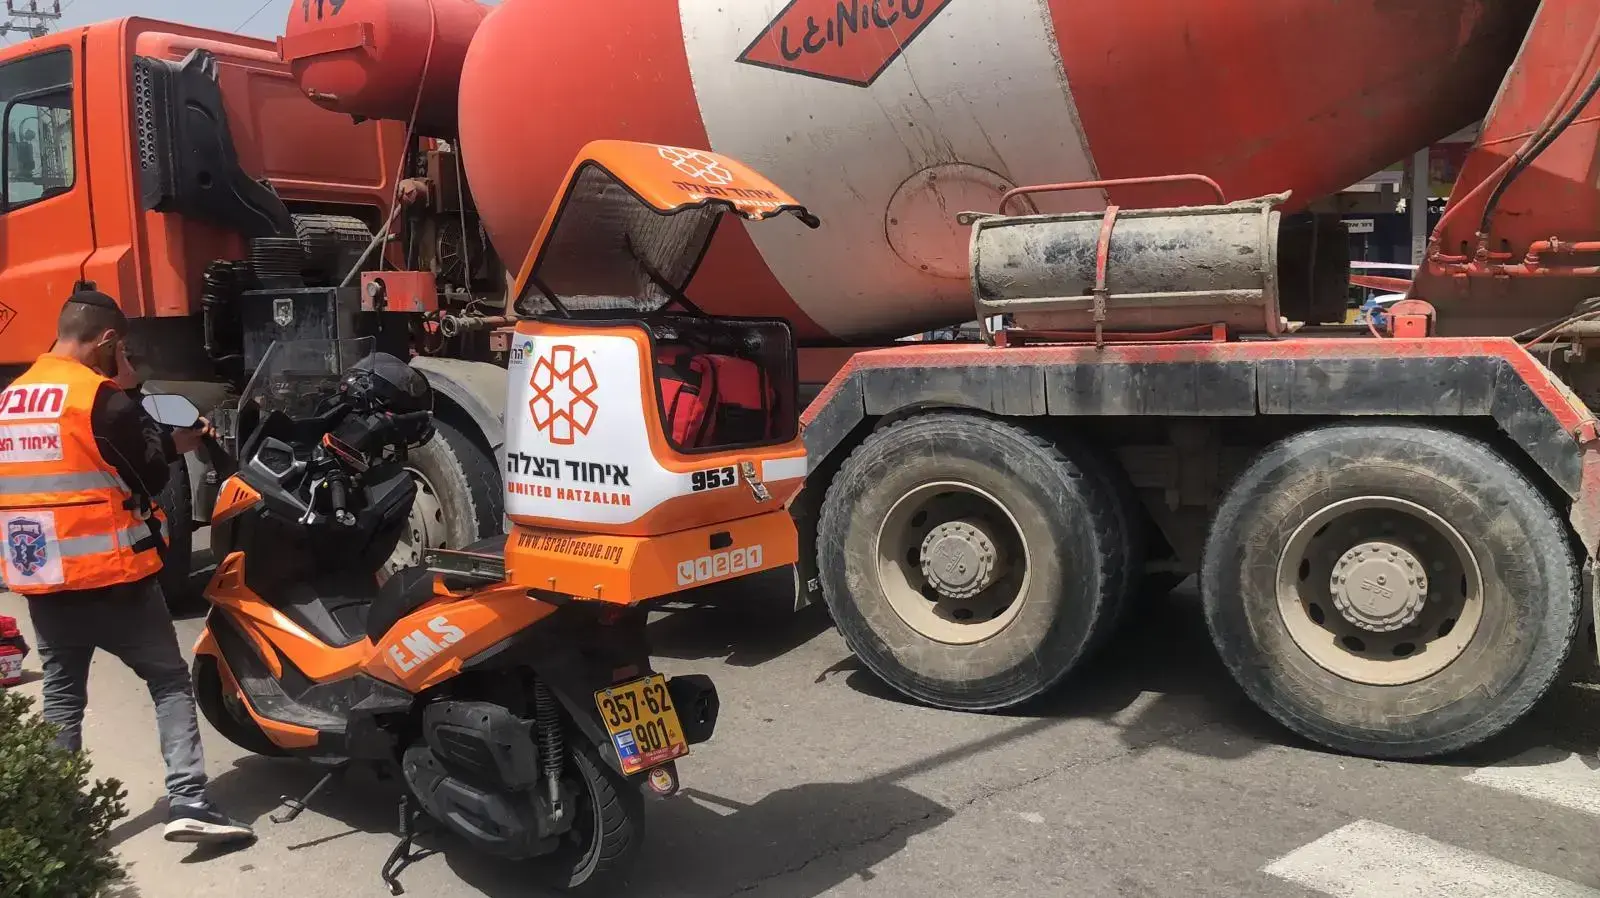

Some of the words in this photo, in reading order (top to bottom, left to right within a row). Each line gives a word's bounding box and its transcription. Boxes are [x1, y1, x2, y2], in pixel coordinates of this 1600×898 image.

[672, 180, 728, 196] הצלה
[725, 187, 779, 199] איחוד
[18, 435, 59, 450] איחוד
[507, 451, 560, 479] הצלה
[565, 460, 631, 486] איחוד
[691, 466, 736, 492] 953
[507, 481, 552, 498] UNITED
[556, 487, 632, 507] HATZALAH
[517, 532, 624, 565] www.israelrescue.org
[697, 548, 760, 577] 1221
[635, 716, 671, 753] 901
